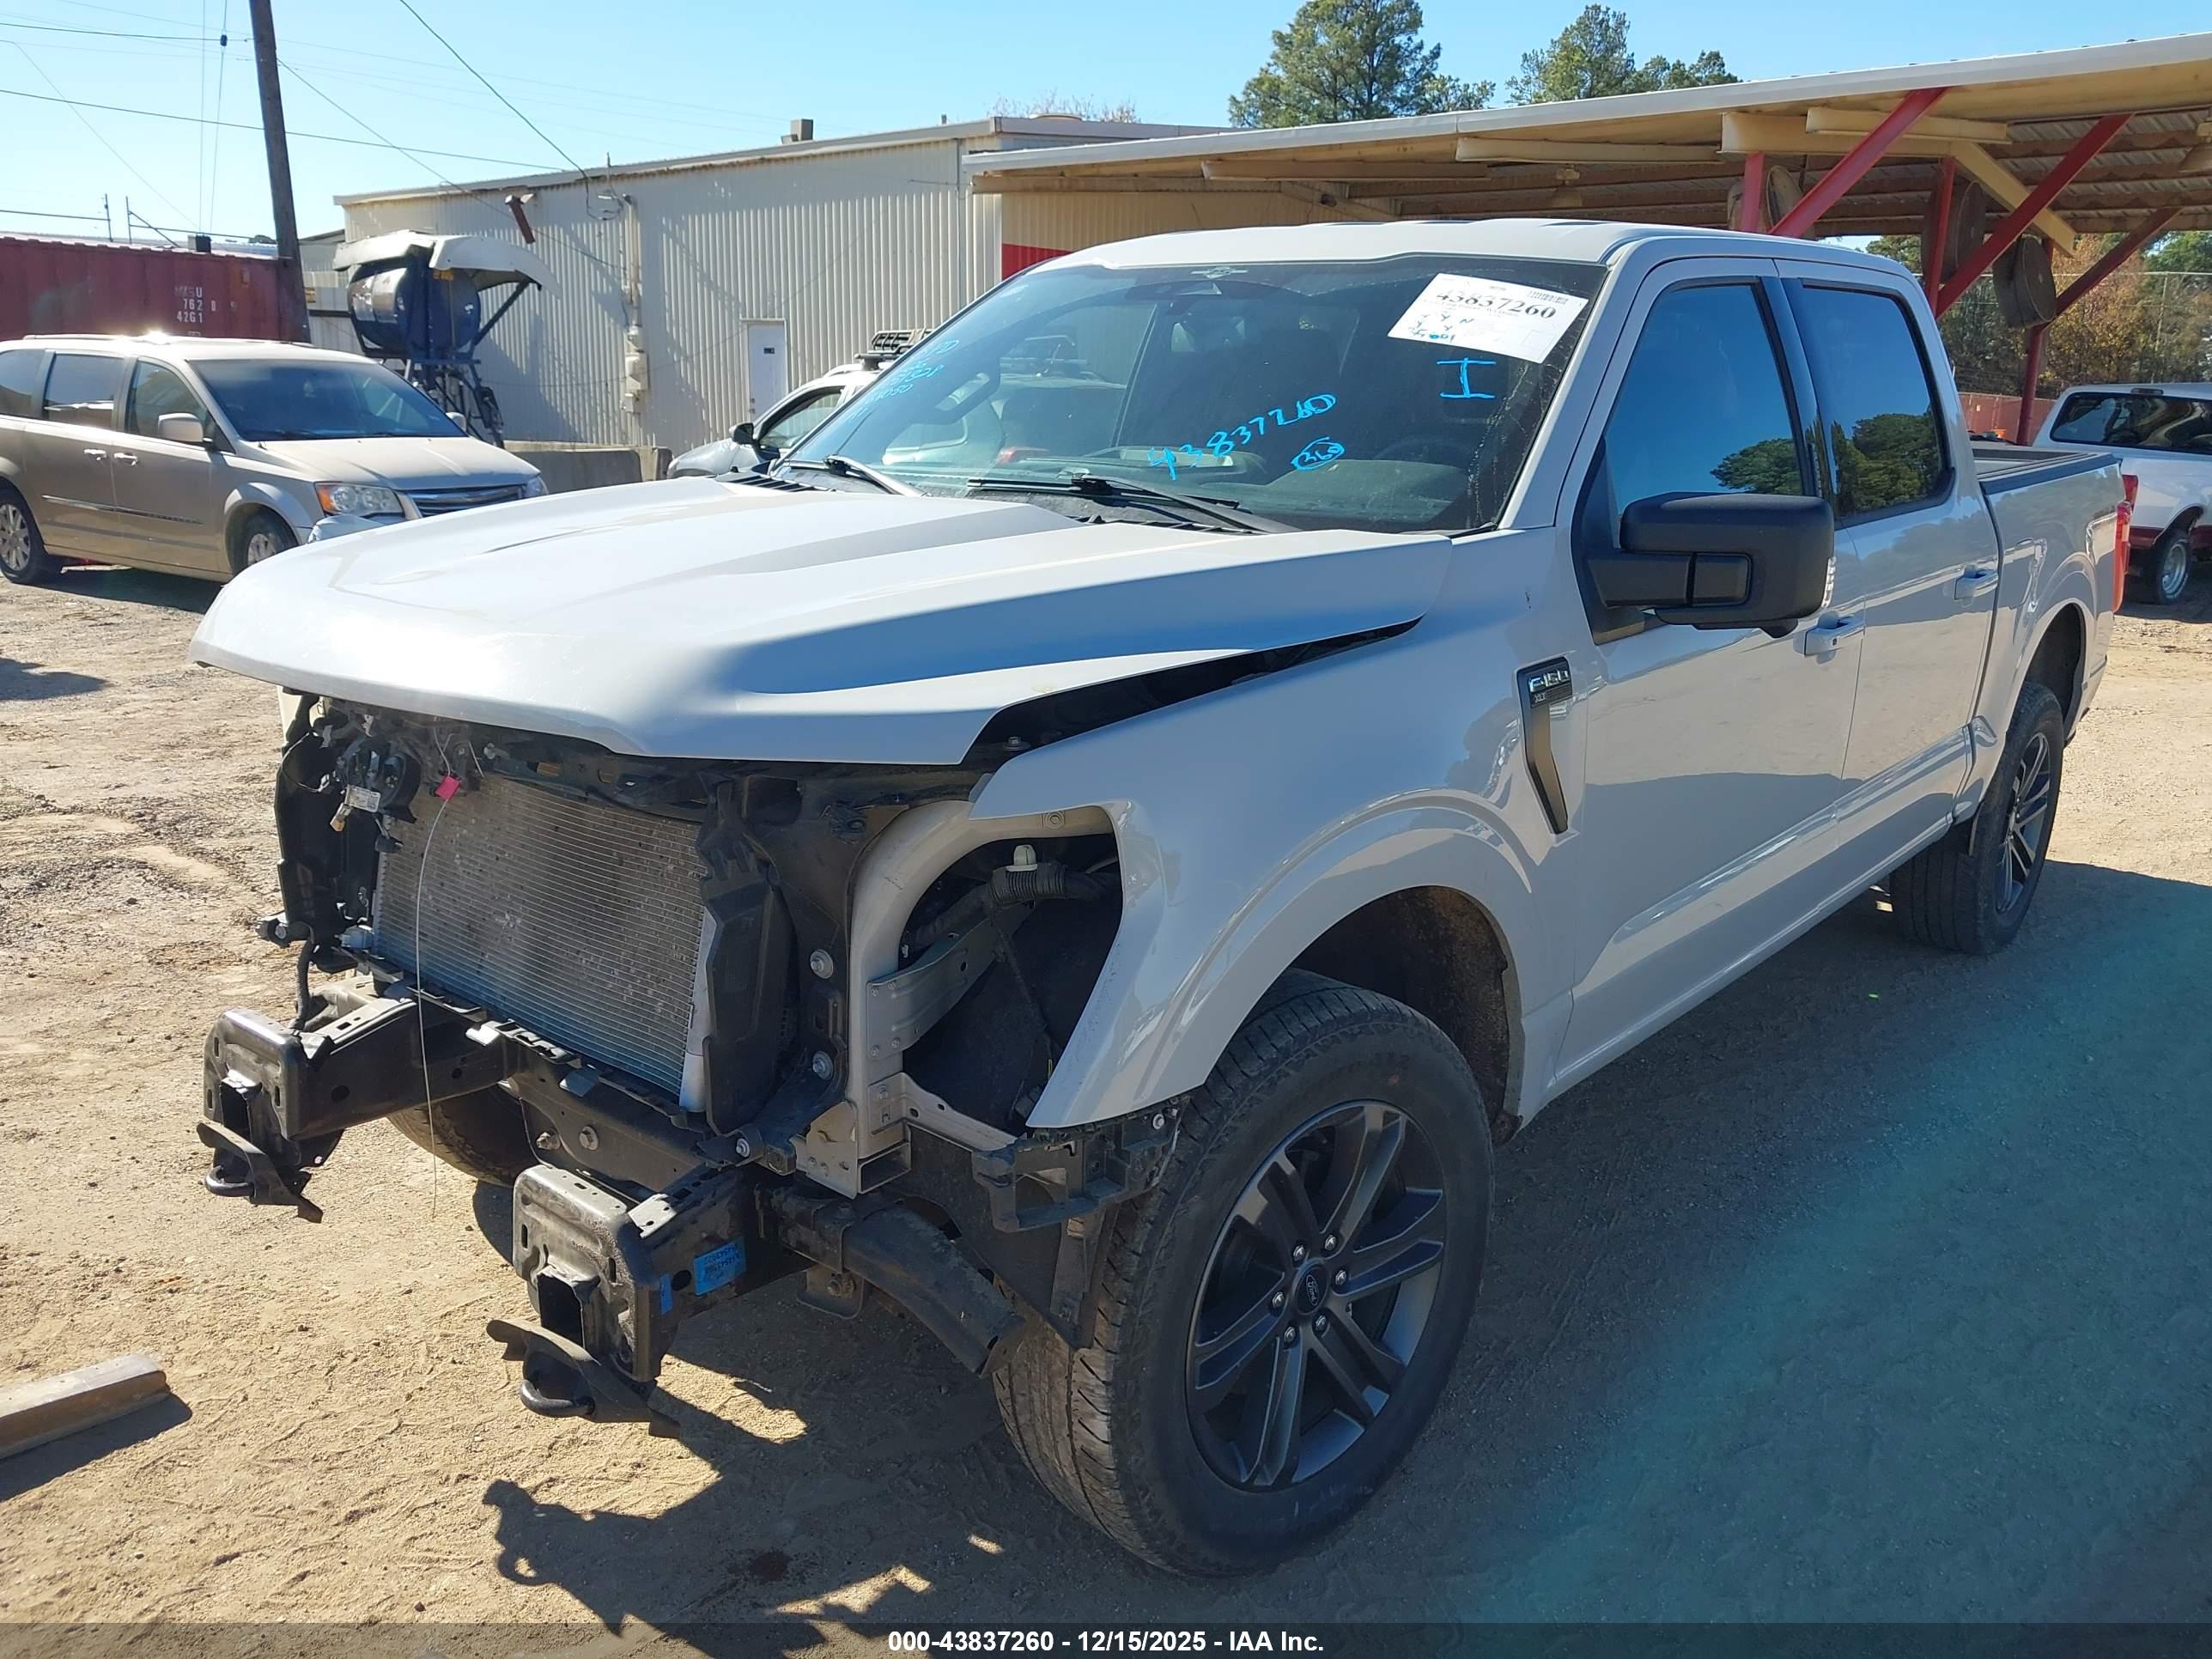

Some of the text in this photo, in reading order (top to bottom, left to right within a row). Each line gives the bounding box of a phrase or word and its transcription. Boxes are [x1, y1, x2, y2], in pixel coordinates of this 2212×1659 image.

[183, 298, 203, 311] 762
[1436, 289, 1557, 319] 43837260
[1146, 393, 1337, 481] 43837260
